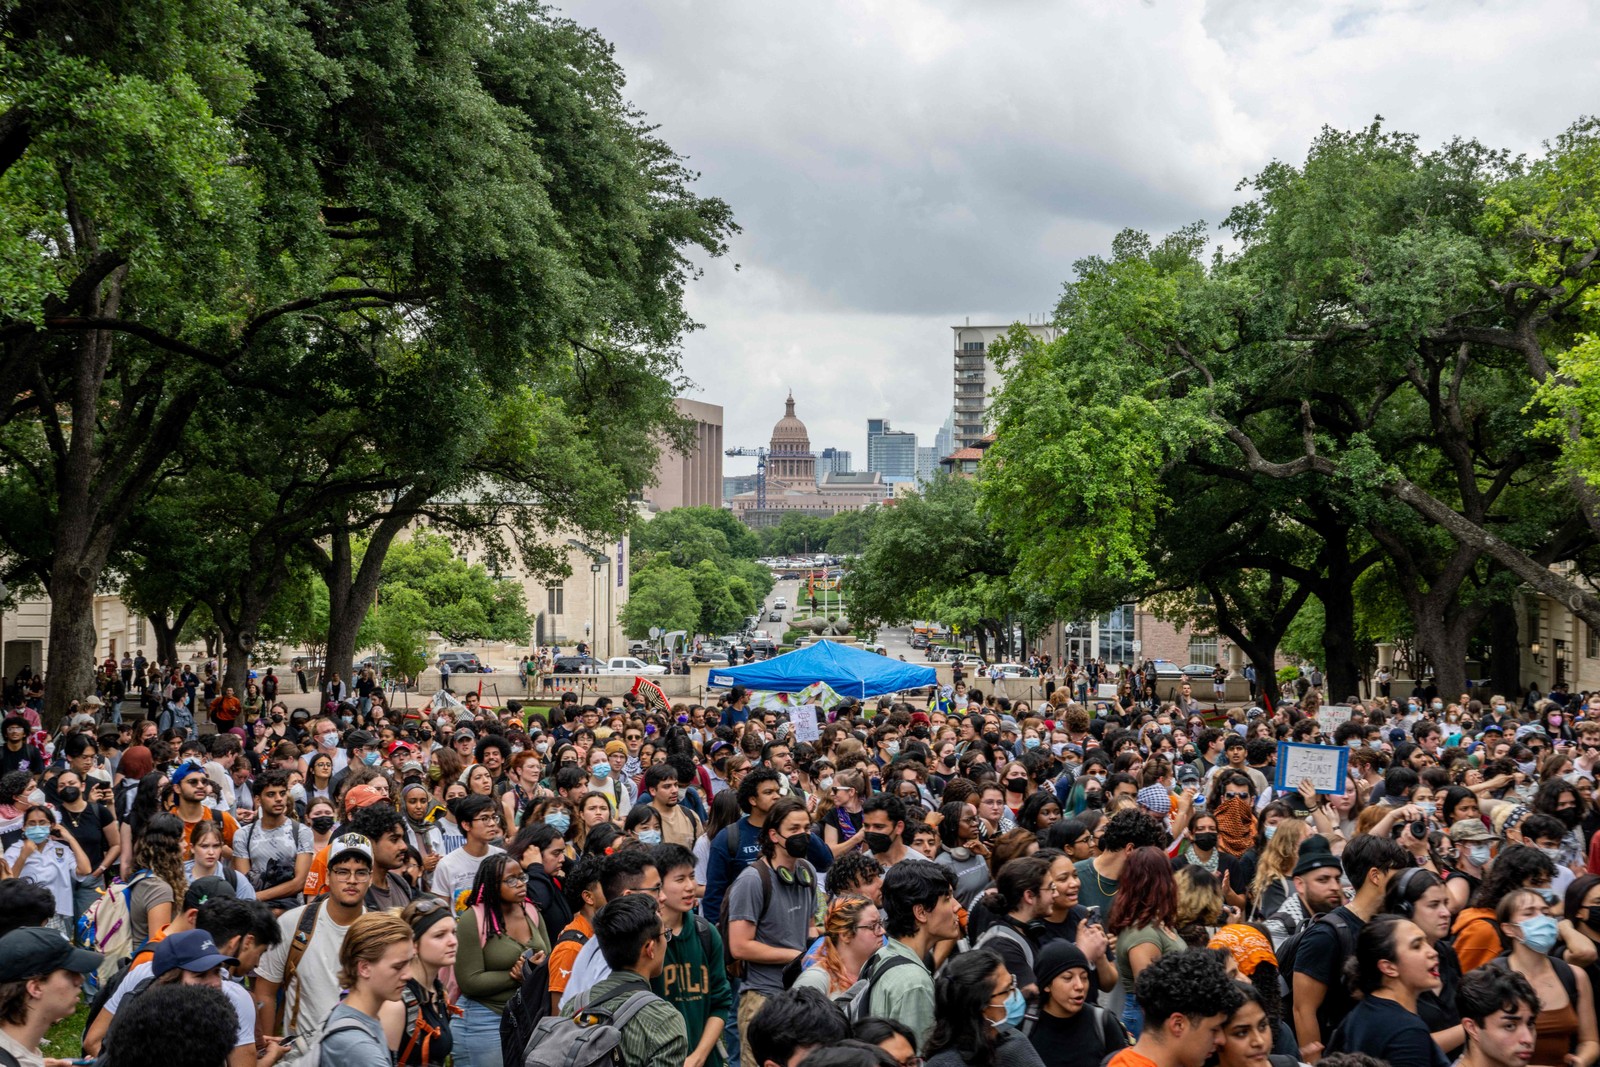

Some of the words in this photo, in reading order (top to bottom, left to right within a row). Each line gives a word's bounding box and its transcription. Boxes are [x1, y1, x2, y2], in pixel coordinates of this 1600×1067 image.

[1302, 751, 1325, 762] JEW
[1291, 761, 1333, 775] AGAINST
[1287, 774, 1333, 788] GECIDE
[742, 845, 763, 854] TEX
